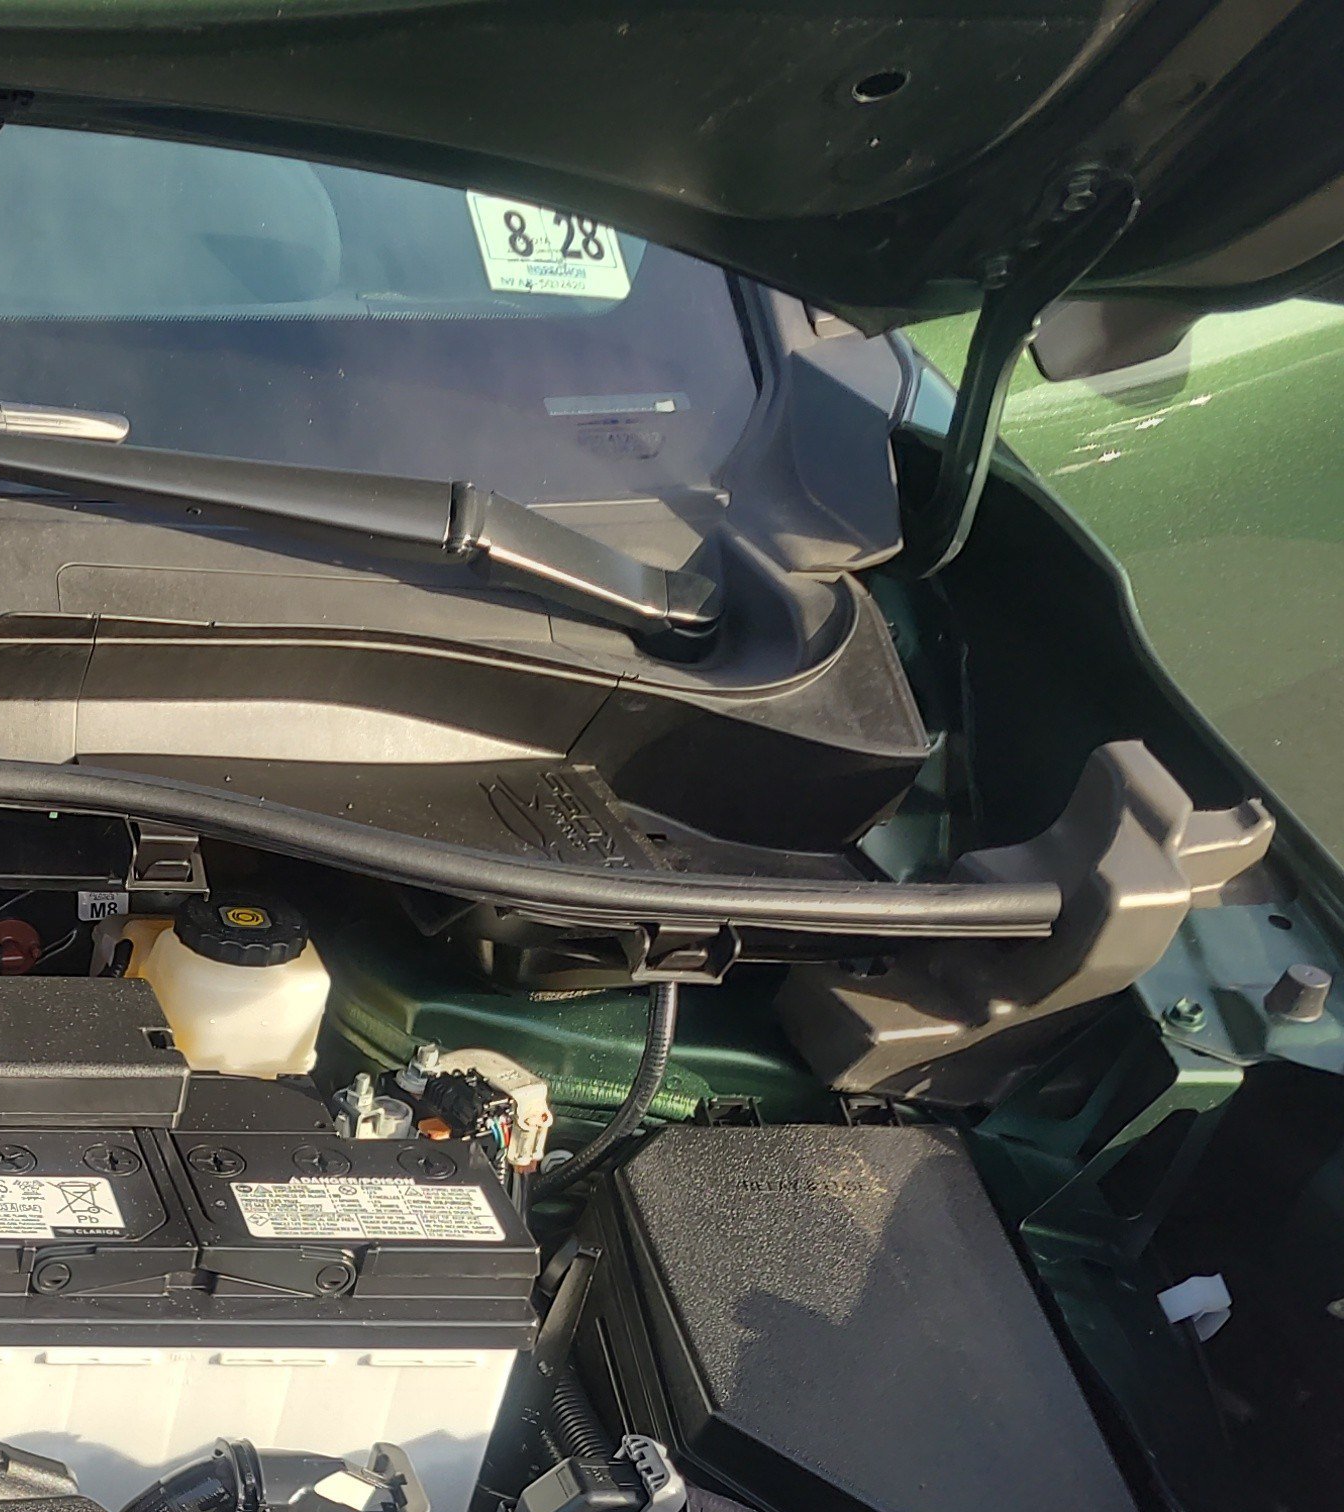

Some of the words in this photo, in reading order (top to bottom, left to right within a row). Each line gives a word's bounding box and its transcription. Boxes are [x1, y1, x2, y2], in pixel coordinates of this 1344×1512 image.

[504, 210, 534, 257] 8
[553, 213, 605, 261] 28
[77, 1215, 99, 1224] Pb
